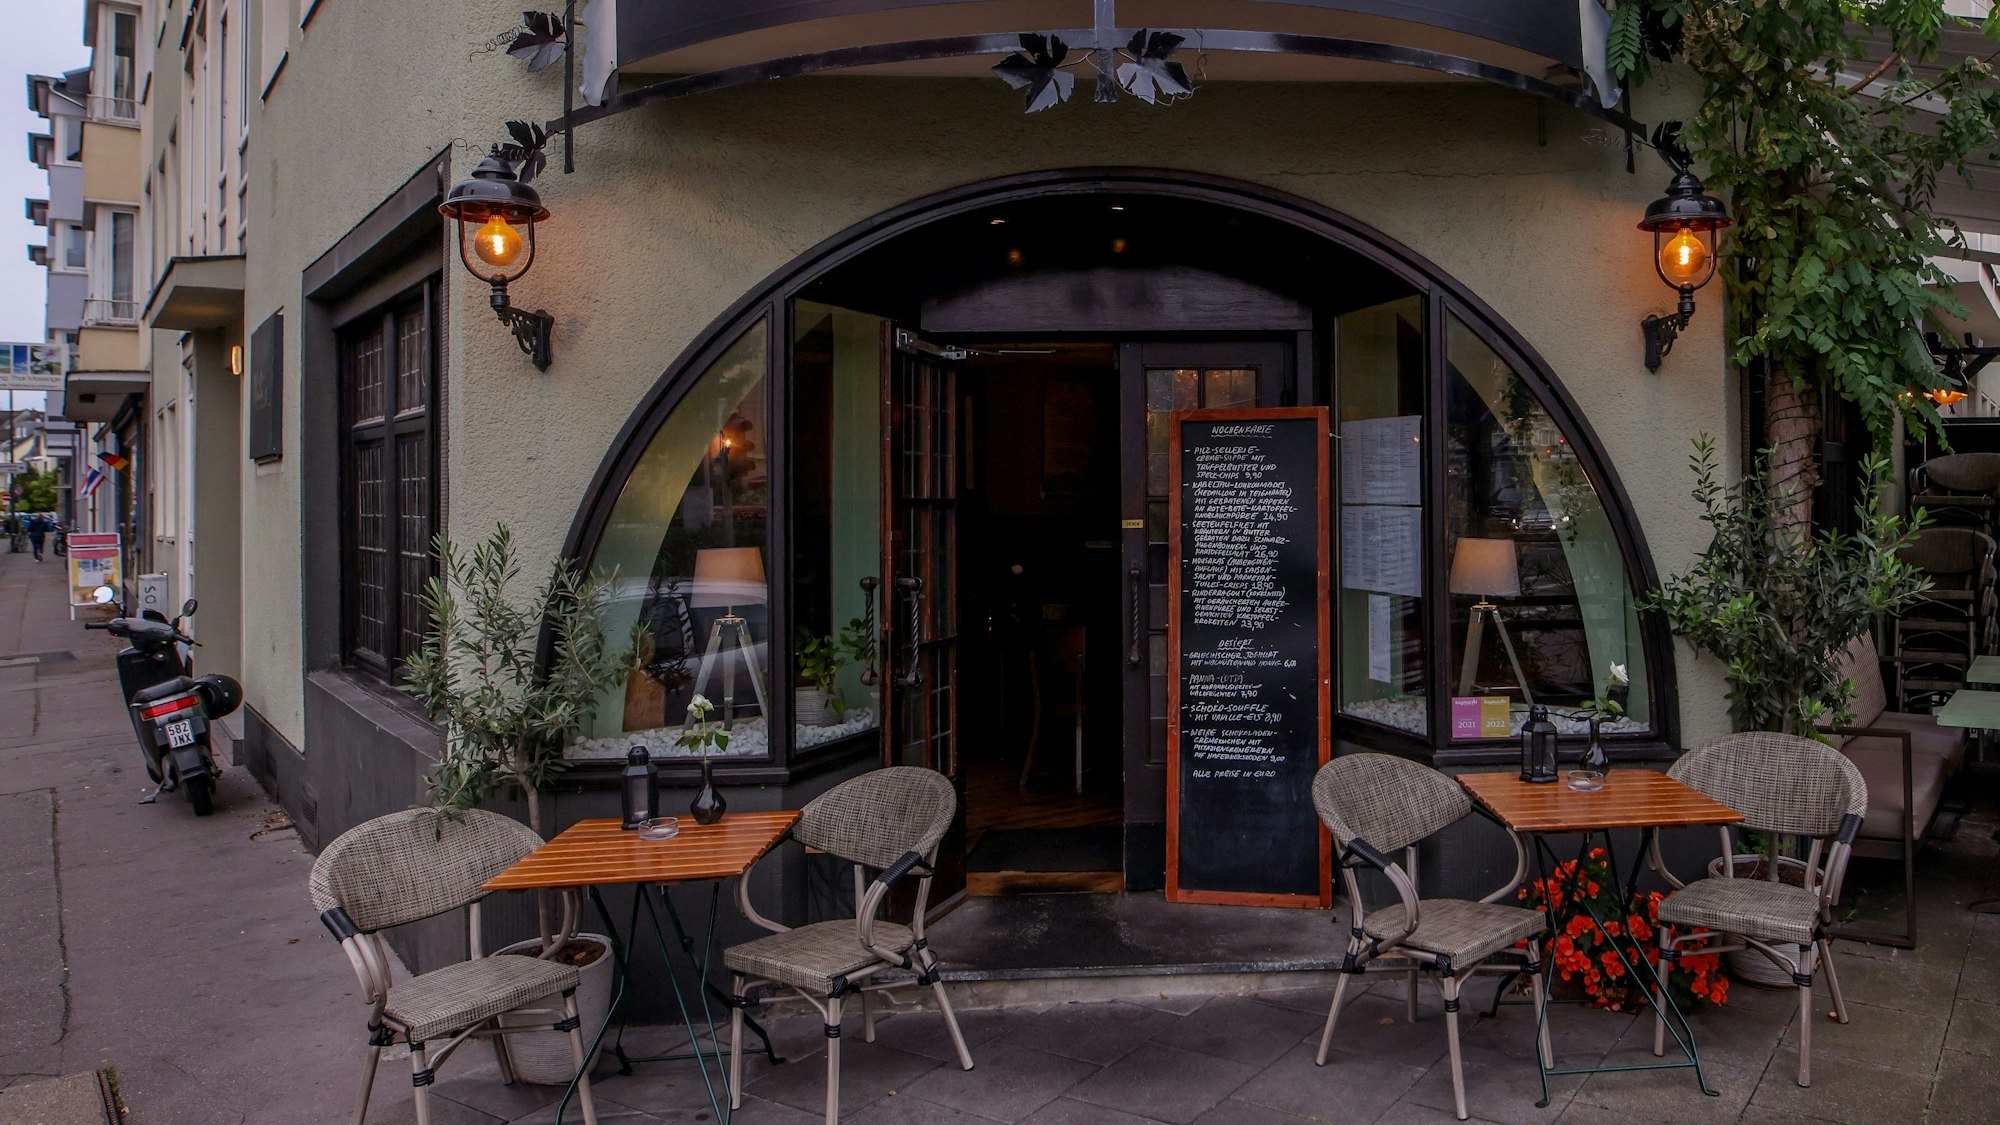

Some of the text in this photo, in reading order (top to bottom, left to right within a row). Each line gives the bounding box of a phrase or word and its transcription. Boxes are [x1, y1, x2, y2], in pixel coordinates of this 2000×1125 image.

[1212, 425, 1275, 434] WOCHENKARTE
[1197, 463, 1258, 471] TRÜFFELBUTTER
[1195, 549, 1250, 557] KARTOFFELSALAT
[1195, 565, 1227, 574] AUFLAUF)
[1252, 582, 1274, 590] 18,90
[1192, 589, 1245, 597] RINDERRAGOUT
[1207, 597, 1260, 606] GERÄUCHERTEM
[1241, 621, 1264, 631] 23,90
[1218, 639, 1254, 649] DESSERT
[1243, 651, 1279, 659] JOGHURT
[1241, 691, 1257, 699] 7,90
[1486, 720, 1504, 728] 2022
[168, 722, 188, 736] 582
[174, 732, 192, 746] JNX
